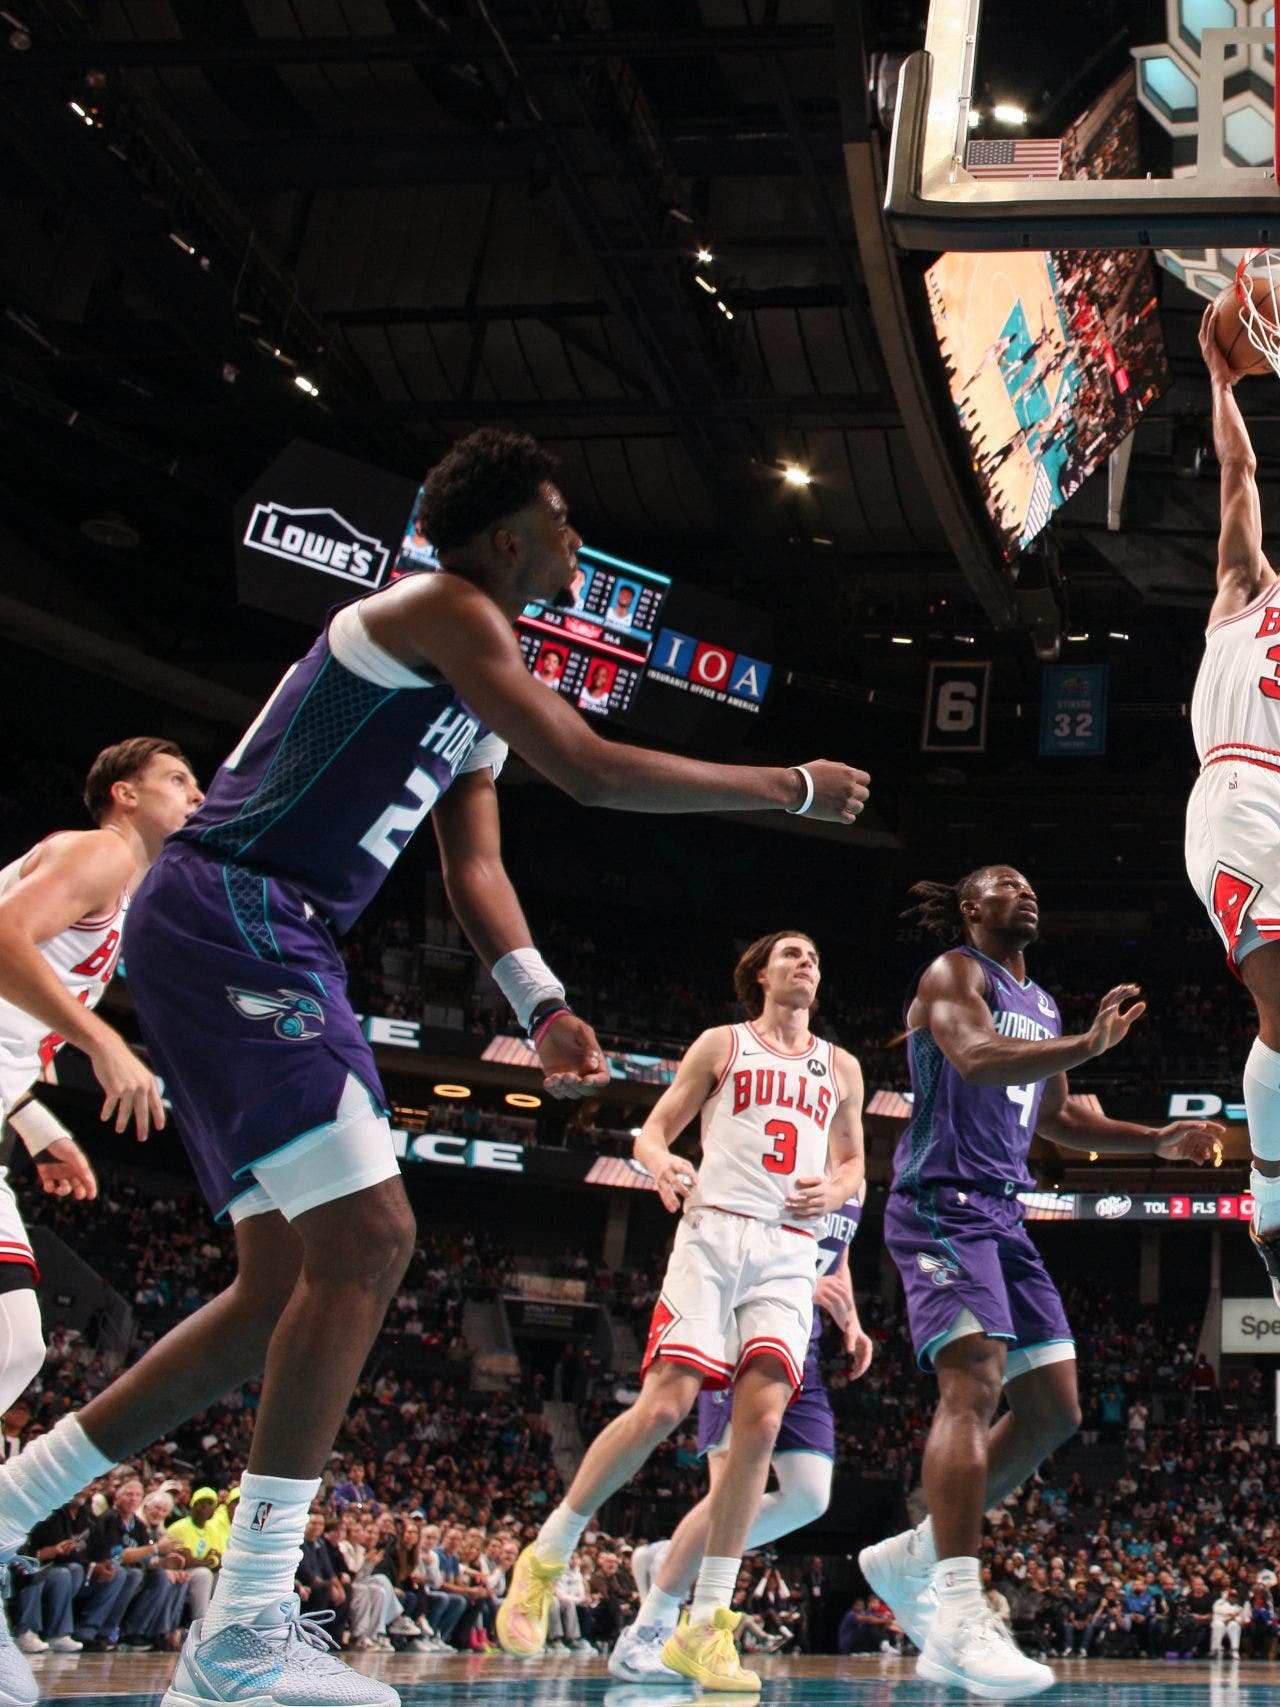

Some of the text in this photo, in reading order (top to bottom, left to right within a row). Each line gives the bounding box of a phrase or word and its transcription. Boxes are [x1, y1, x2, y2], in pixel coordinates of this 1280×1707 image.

[262, 514, 373, 577] LOWE'S
[646, 668, 690, 691] INSURANCE
[690, 683, 716, 700] OFFICE
[716, 692, 727, 703] OF
[727, 695, 760, 713] AMERICA
[936, 681, 977, 732] 6
[1053, 712, 1094, 737] 32
[358, 766, 442, 870] 2
[733, 1070, 832, 1130] BULLS
[1006, 1083, 1036, 1127] 4
[762, 1119, 798, 1175] 3
[1144, 1202, 1169, 1214] TOL
[1173, 1201, 1184, 1214] 2
[1193, 1202, 1216, 1214] FLS
[1220, 1201, 1232, 1214] 2
